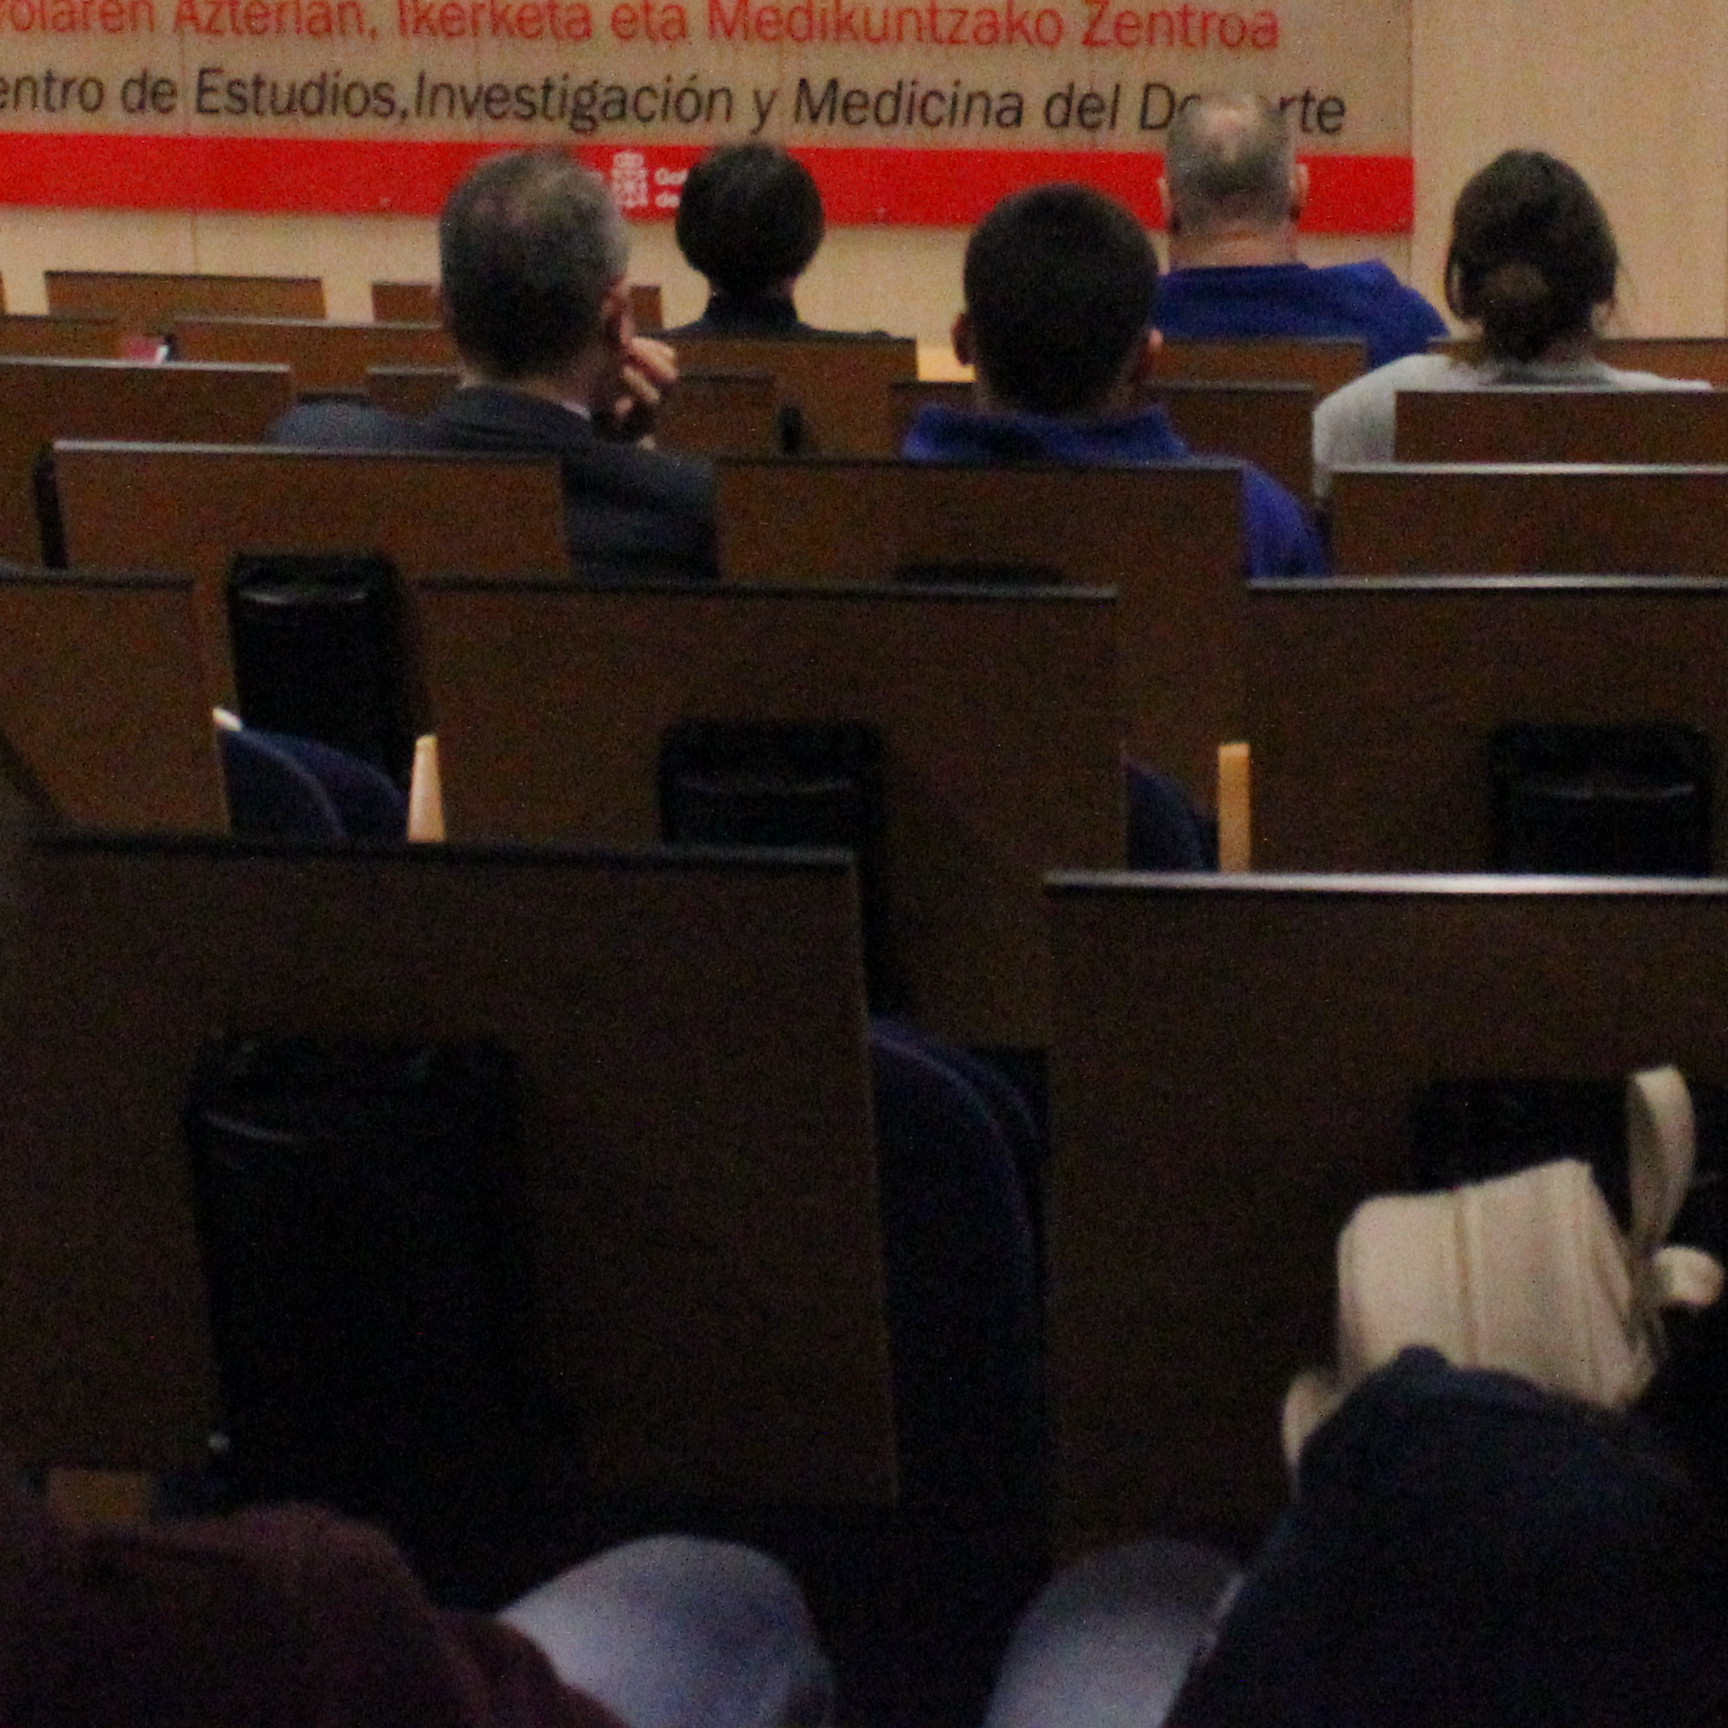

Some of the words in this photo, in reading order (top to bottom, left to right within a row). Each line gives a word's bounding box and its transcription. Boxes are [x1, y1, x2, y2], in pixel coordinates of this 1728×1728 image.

[610, 0, 688, 44] eta
[120, 67, 177, 117] de
[749, 86, 782, 135] y
[793, 76, 1026, 130] Medicina
[1043, 82, 1122, 132] del
[1139, 82, 1347, 134] Drte
